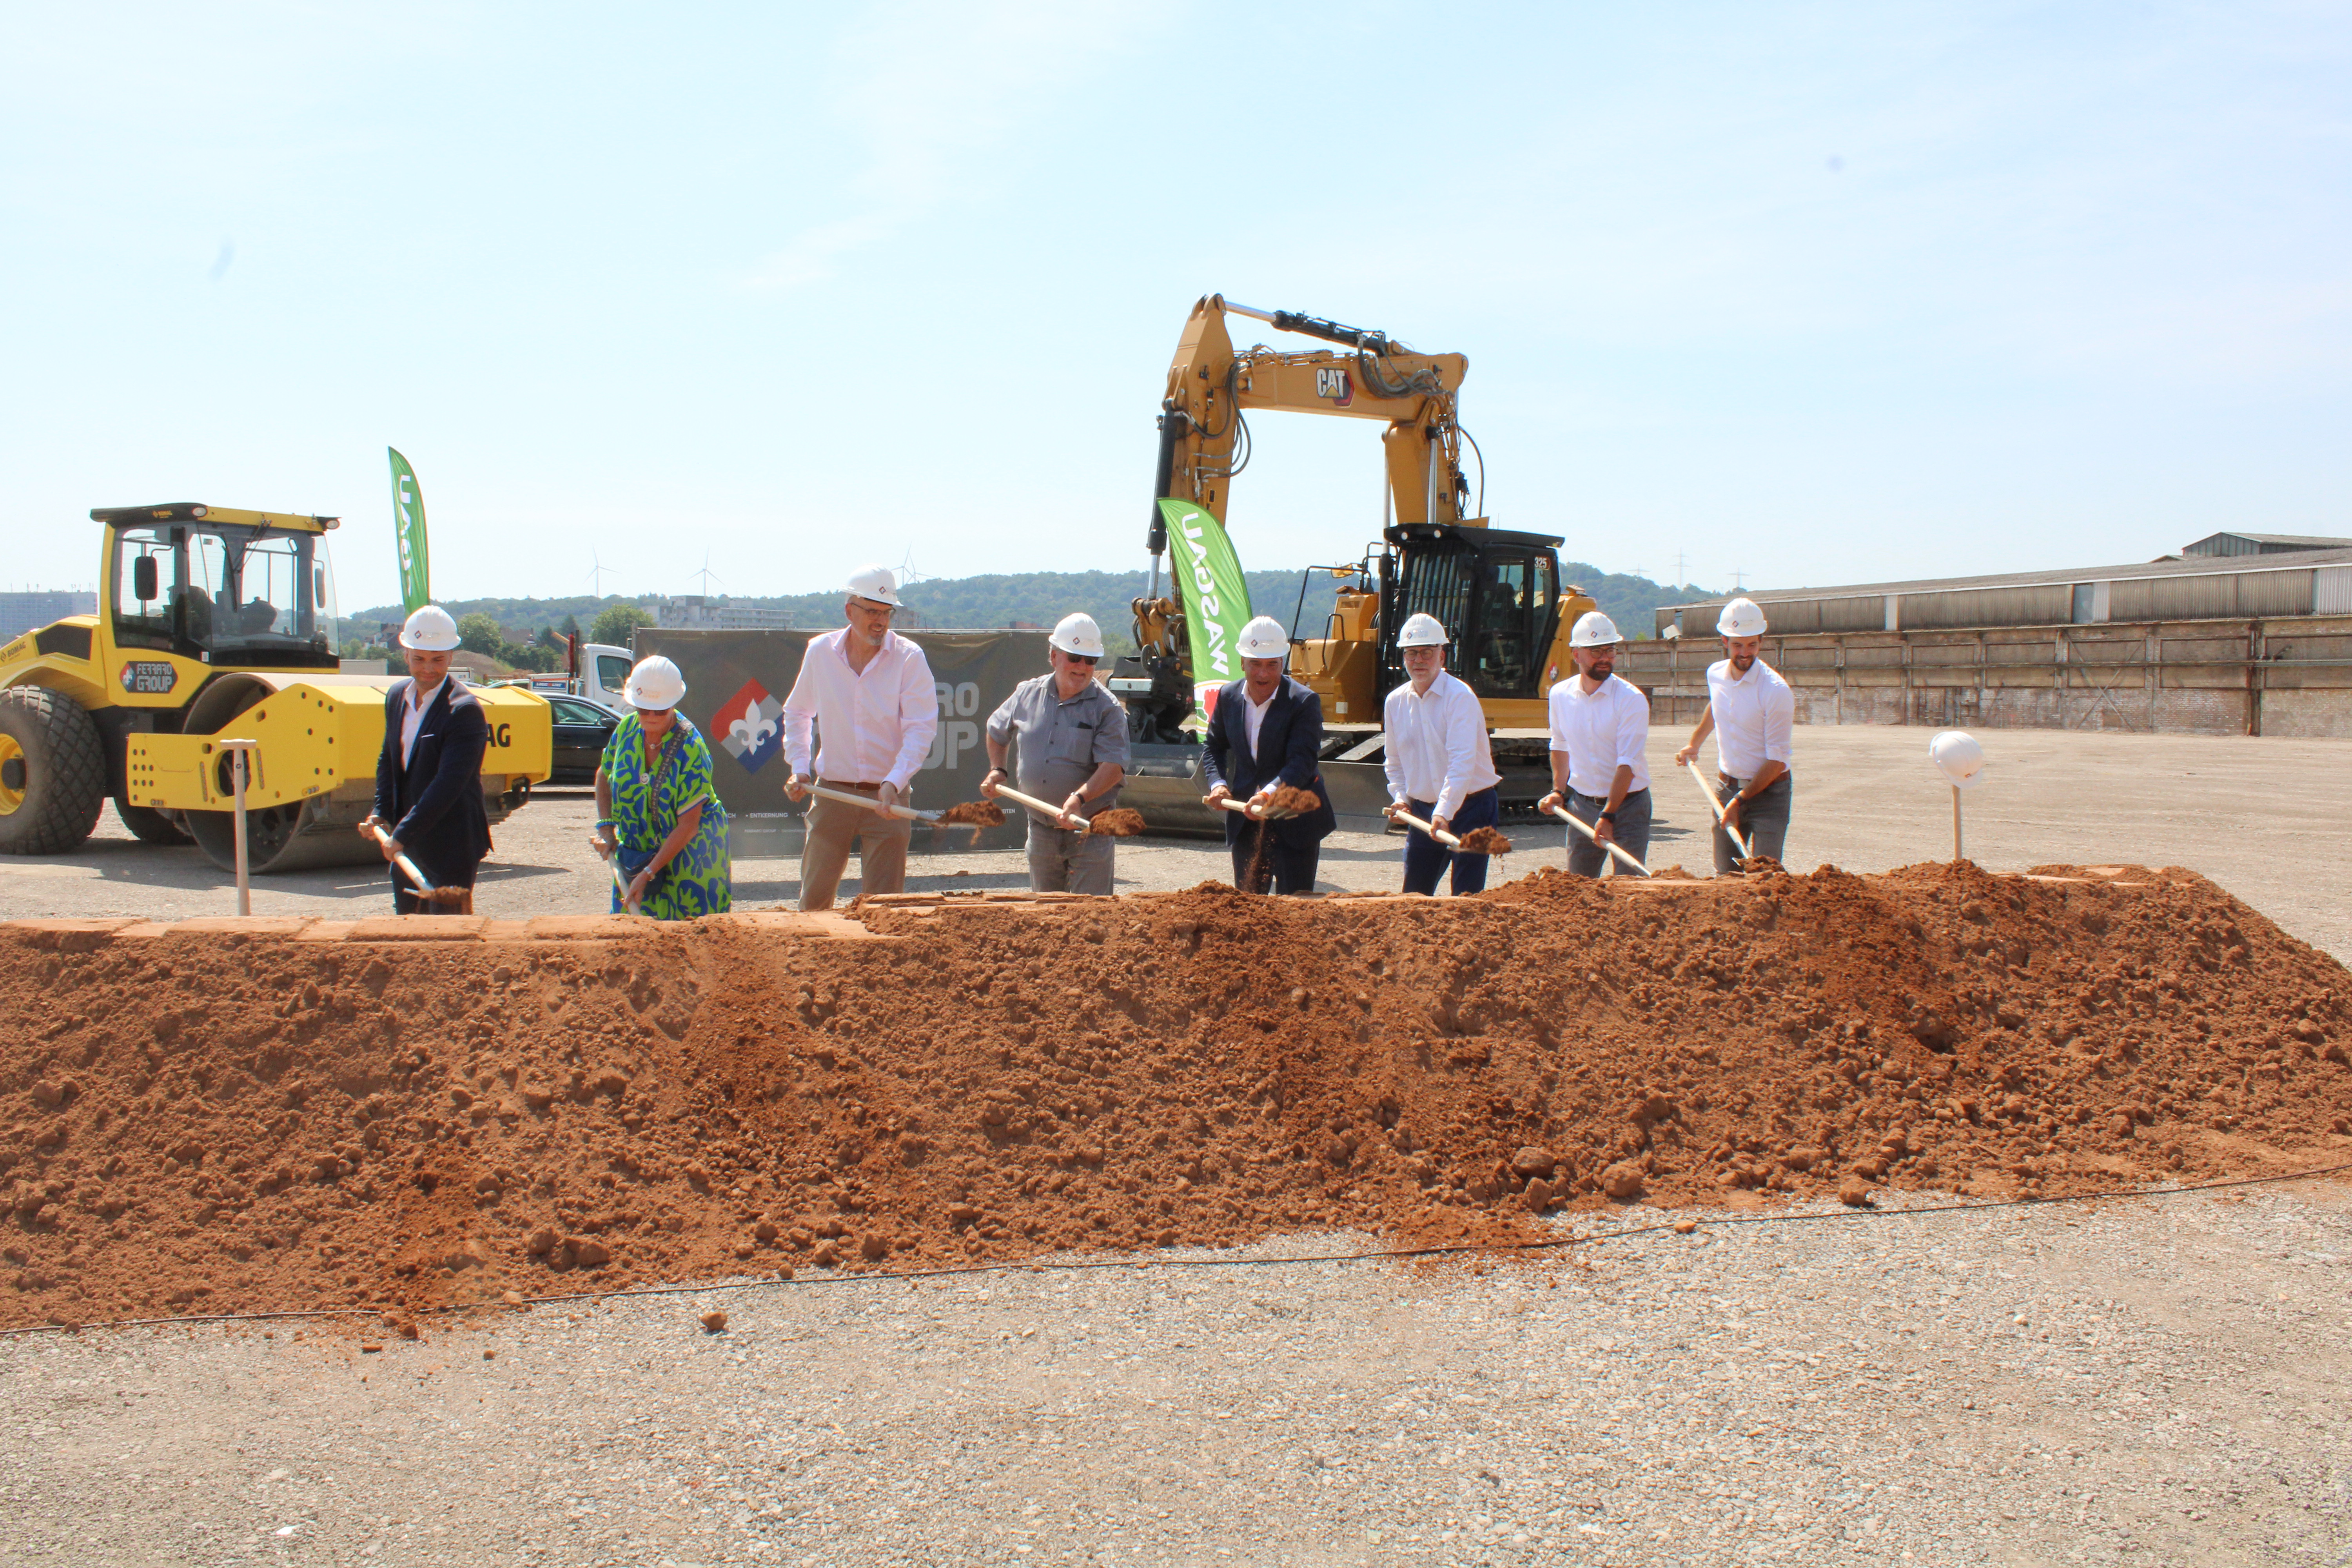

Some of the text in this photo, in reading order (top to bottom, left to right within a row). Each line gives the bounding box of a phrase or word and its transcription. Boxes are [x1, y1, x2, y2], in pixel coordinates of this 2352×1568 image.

[1317, 368, 1345, 397] CAT
[1534, 557, 1547, 568] 325
[137, 675, 172, 691] GROUP
[935, 682, 980, 717] RO
[486, 723, 511, 748] AG
